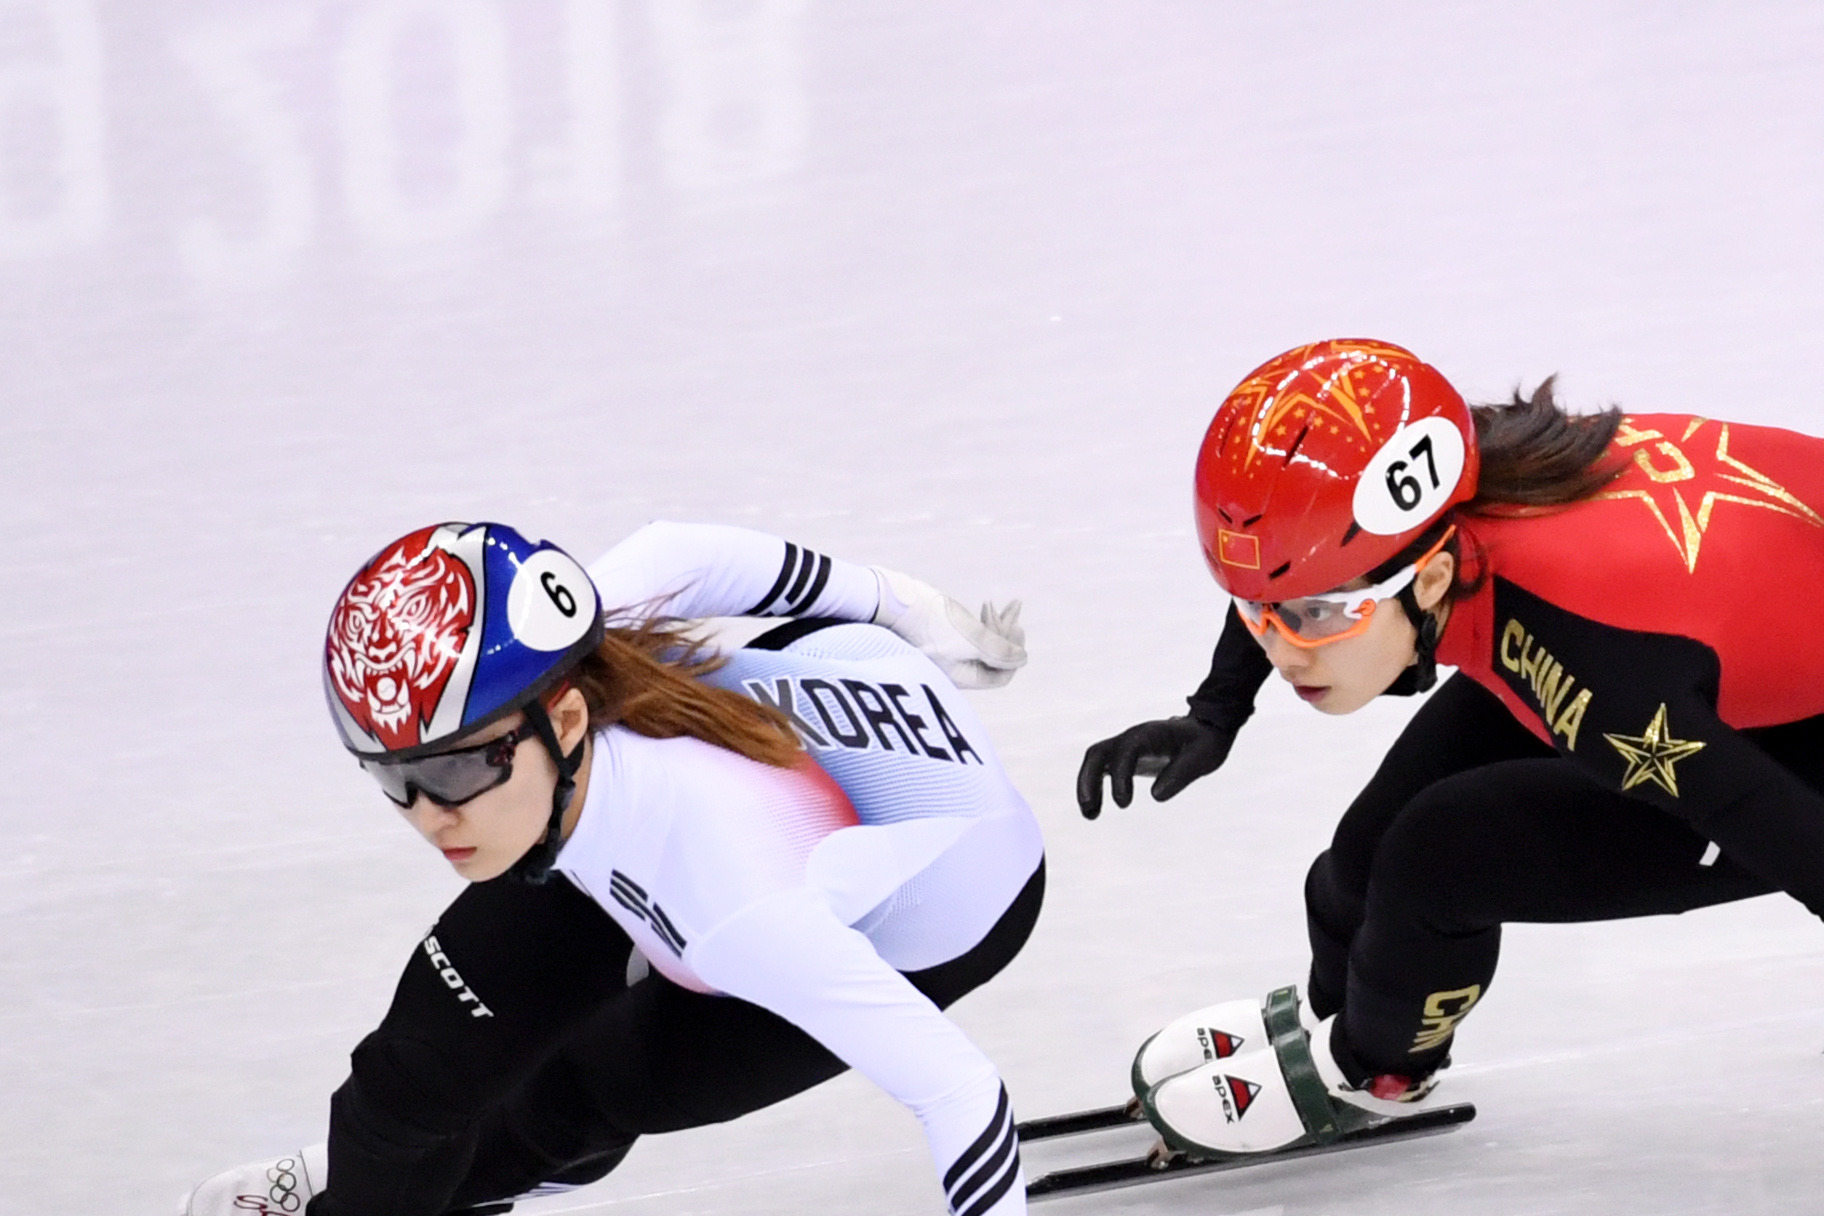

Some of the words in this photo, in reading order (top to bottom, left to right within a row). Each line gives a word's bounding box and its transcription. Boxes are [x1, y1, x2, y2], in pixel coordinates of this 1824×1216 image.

[1386, 434, 1440, 512] 67
[541, 571, 577, 618] 6
[743, 676, 985, 766] KOREA
[1501, 619, 1593, 752] CHINA
[424, 935, 494, 1017] SCOTT
[1197, 1027, 1214, 1063] ape
[1212, 1074, 1235, 1124] apex
